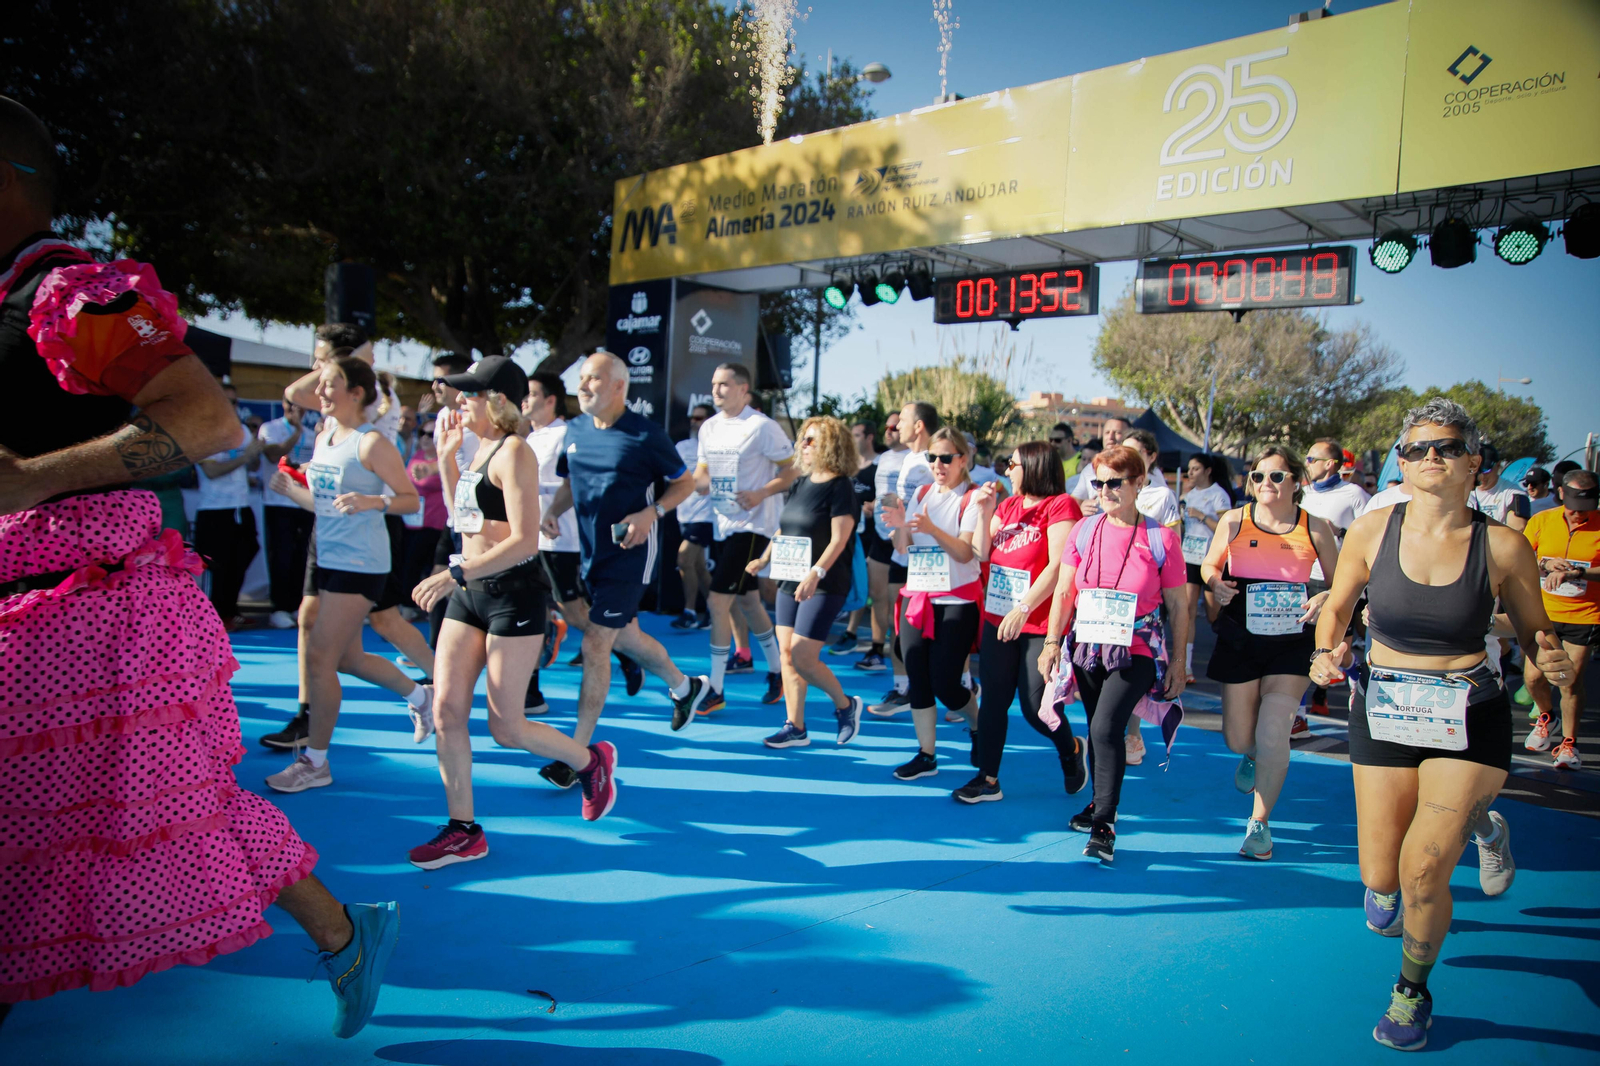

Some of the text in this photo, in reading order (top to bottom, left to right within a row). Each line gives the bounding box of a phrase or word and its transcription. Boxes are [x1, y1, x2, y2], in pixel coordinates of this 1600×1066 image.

[1444, 71, 1566, 105] COOPERACIÓN
[1160, 46, 1298, 167] 25
[1443, 101, 1481, 118] 2005
[1156, 157, 1293, 201] EDICIÓN
[707, 174, 838, 212] Medio Maratón
[847, 180, 1019, 219] RAMÓN RUIZ ANDÚJAR
[705, 197, 836, 239] Almería 2024
[956, 269, 1083, 318] 00:13:52
[616, 313, 662, 335] cajamar
[688, 335, 743, 351] COOPERACIÓN
[912, 552, 945, 567] 5750
[992, 574, 1024, 594] 5559
[1253, 592, 1302, 608] 5332
[1376, 682, 1457, 709] 5129
[1395, 704, 1433, 714] TORTUGA
